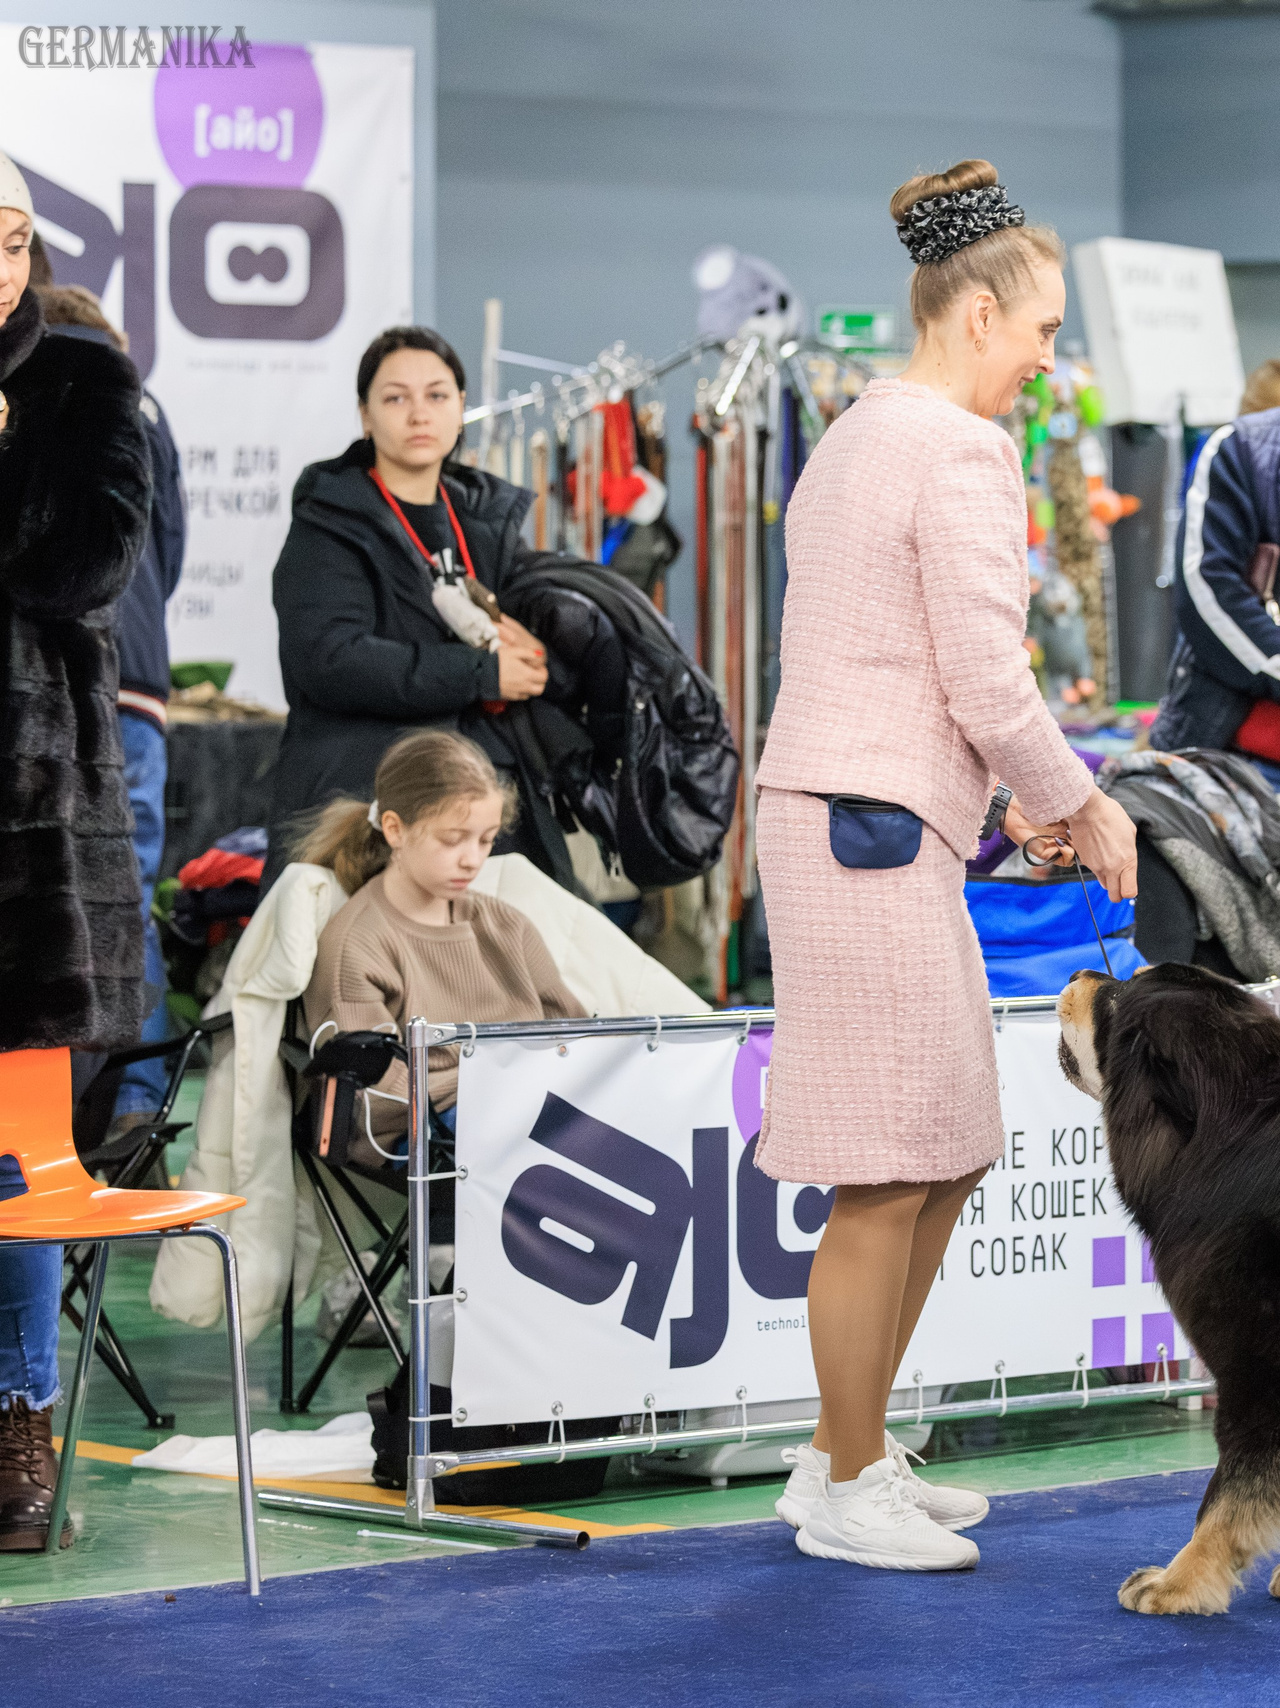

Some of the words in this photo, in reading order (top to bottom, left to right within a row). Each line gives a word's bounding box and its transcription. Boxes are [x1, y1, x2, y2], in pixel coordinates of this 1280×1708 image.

[990, 1131, 1025, 1172] Е
[1011, 1177, 1107, 1222] КОШЕК
[970, 1232, 1067, 1278] СОБАК
